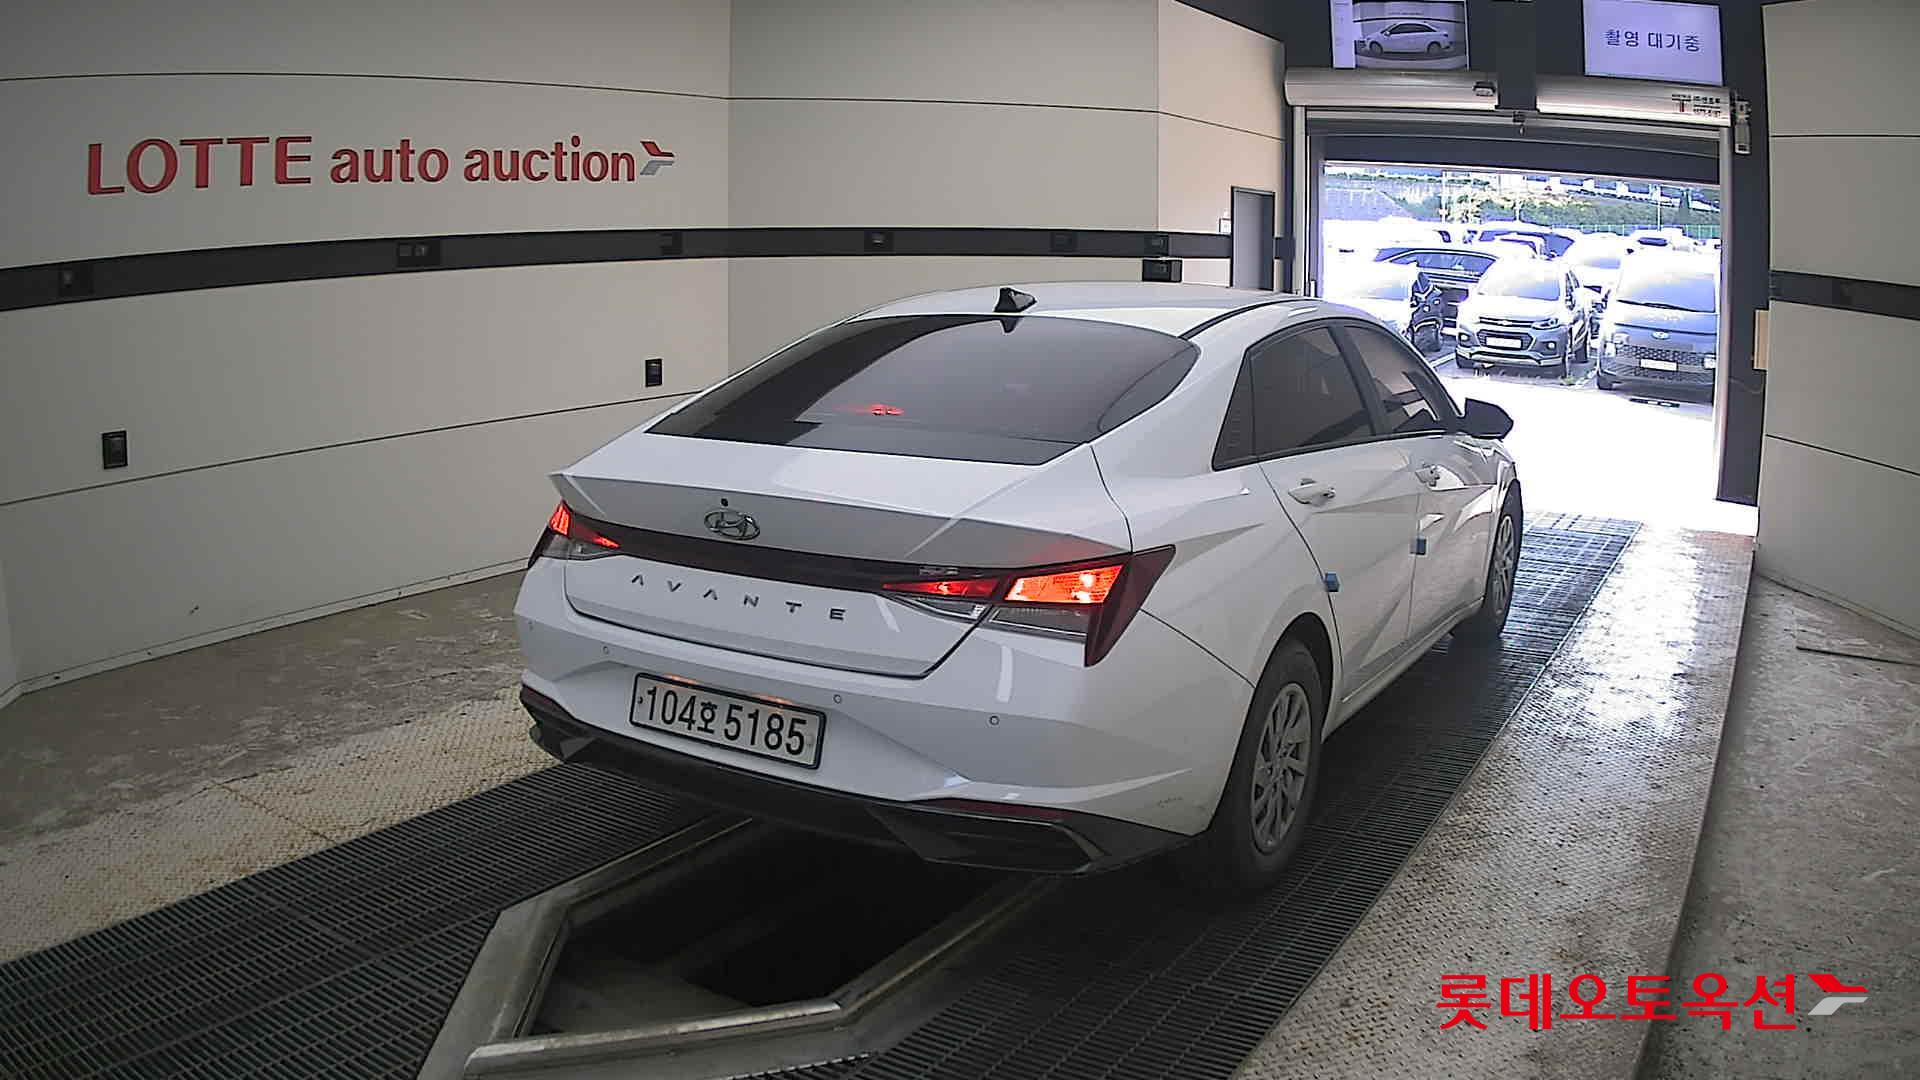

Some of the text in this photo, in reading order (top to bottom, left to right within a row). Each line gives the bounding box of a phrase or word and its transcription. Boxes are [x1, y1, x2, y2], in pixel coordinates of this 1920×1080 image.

[1648, 32, 1700, 52] 대기중
[87, 136, 635, 195] LOTTE auto auction
[631, 574, 846, 621] AVANTE
